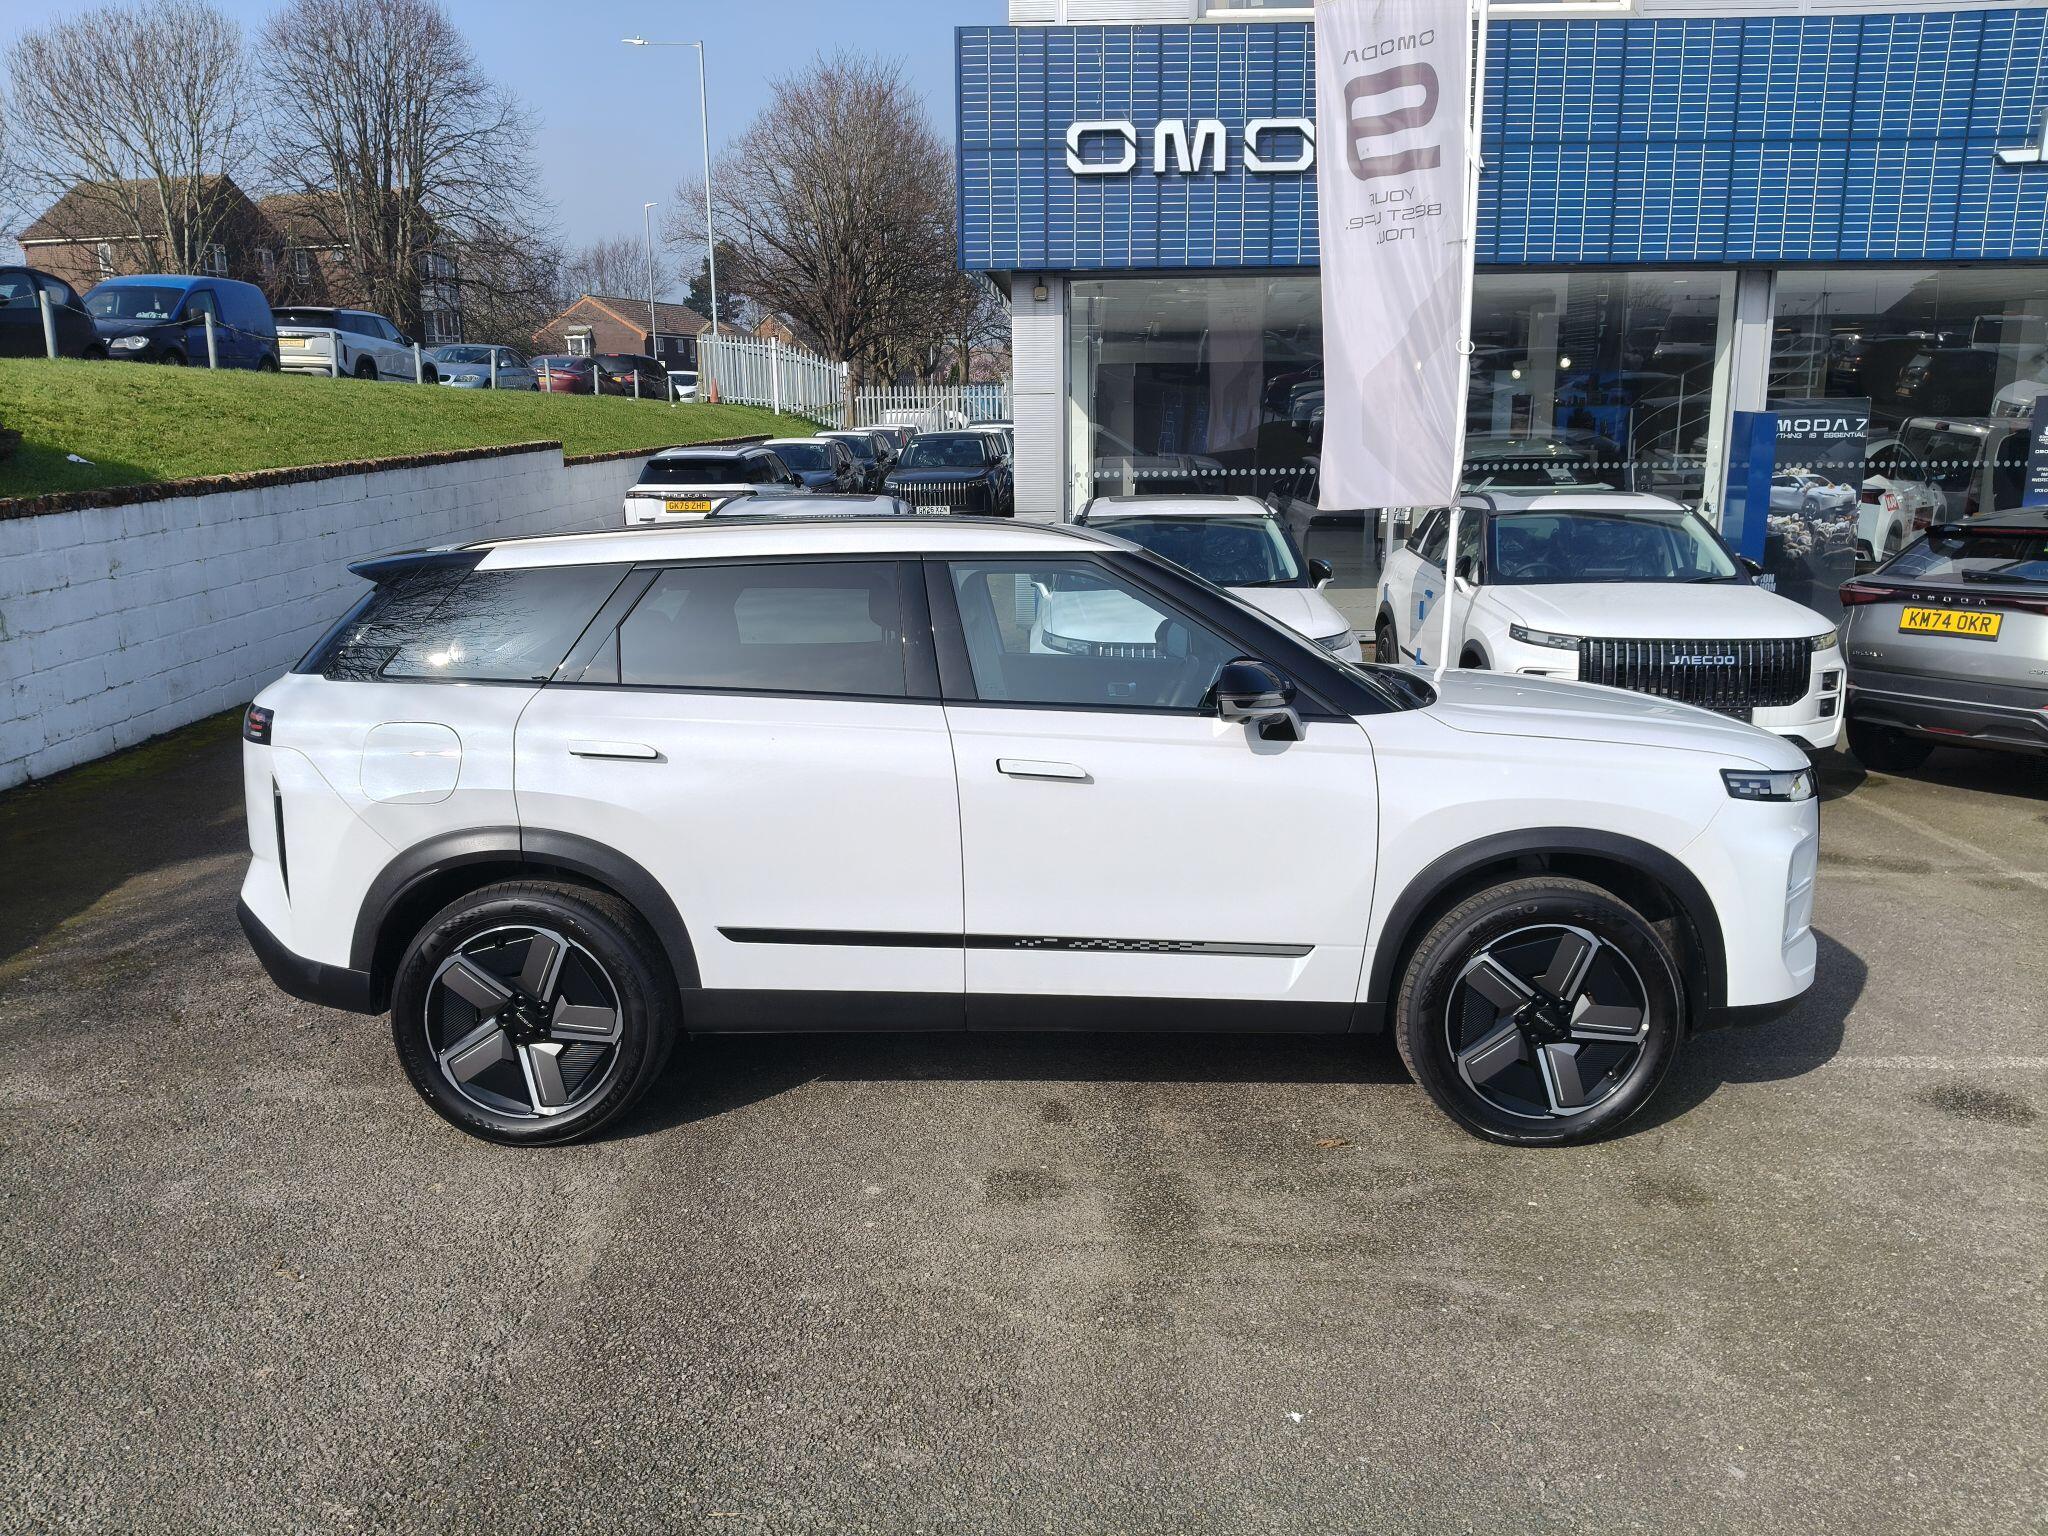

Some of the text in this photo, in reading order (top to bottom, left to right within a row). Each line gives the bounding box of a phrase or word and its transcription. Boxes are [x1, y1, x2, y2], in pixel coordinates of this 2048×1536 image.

[1066, 118, 1315, 174] OMO
[1776, 418, 1868, 432] MODA 7
[1908, 611, 1992, 633] KM74 OKR
[1669, 655, 1735, 665] JAECOO
